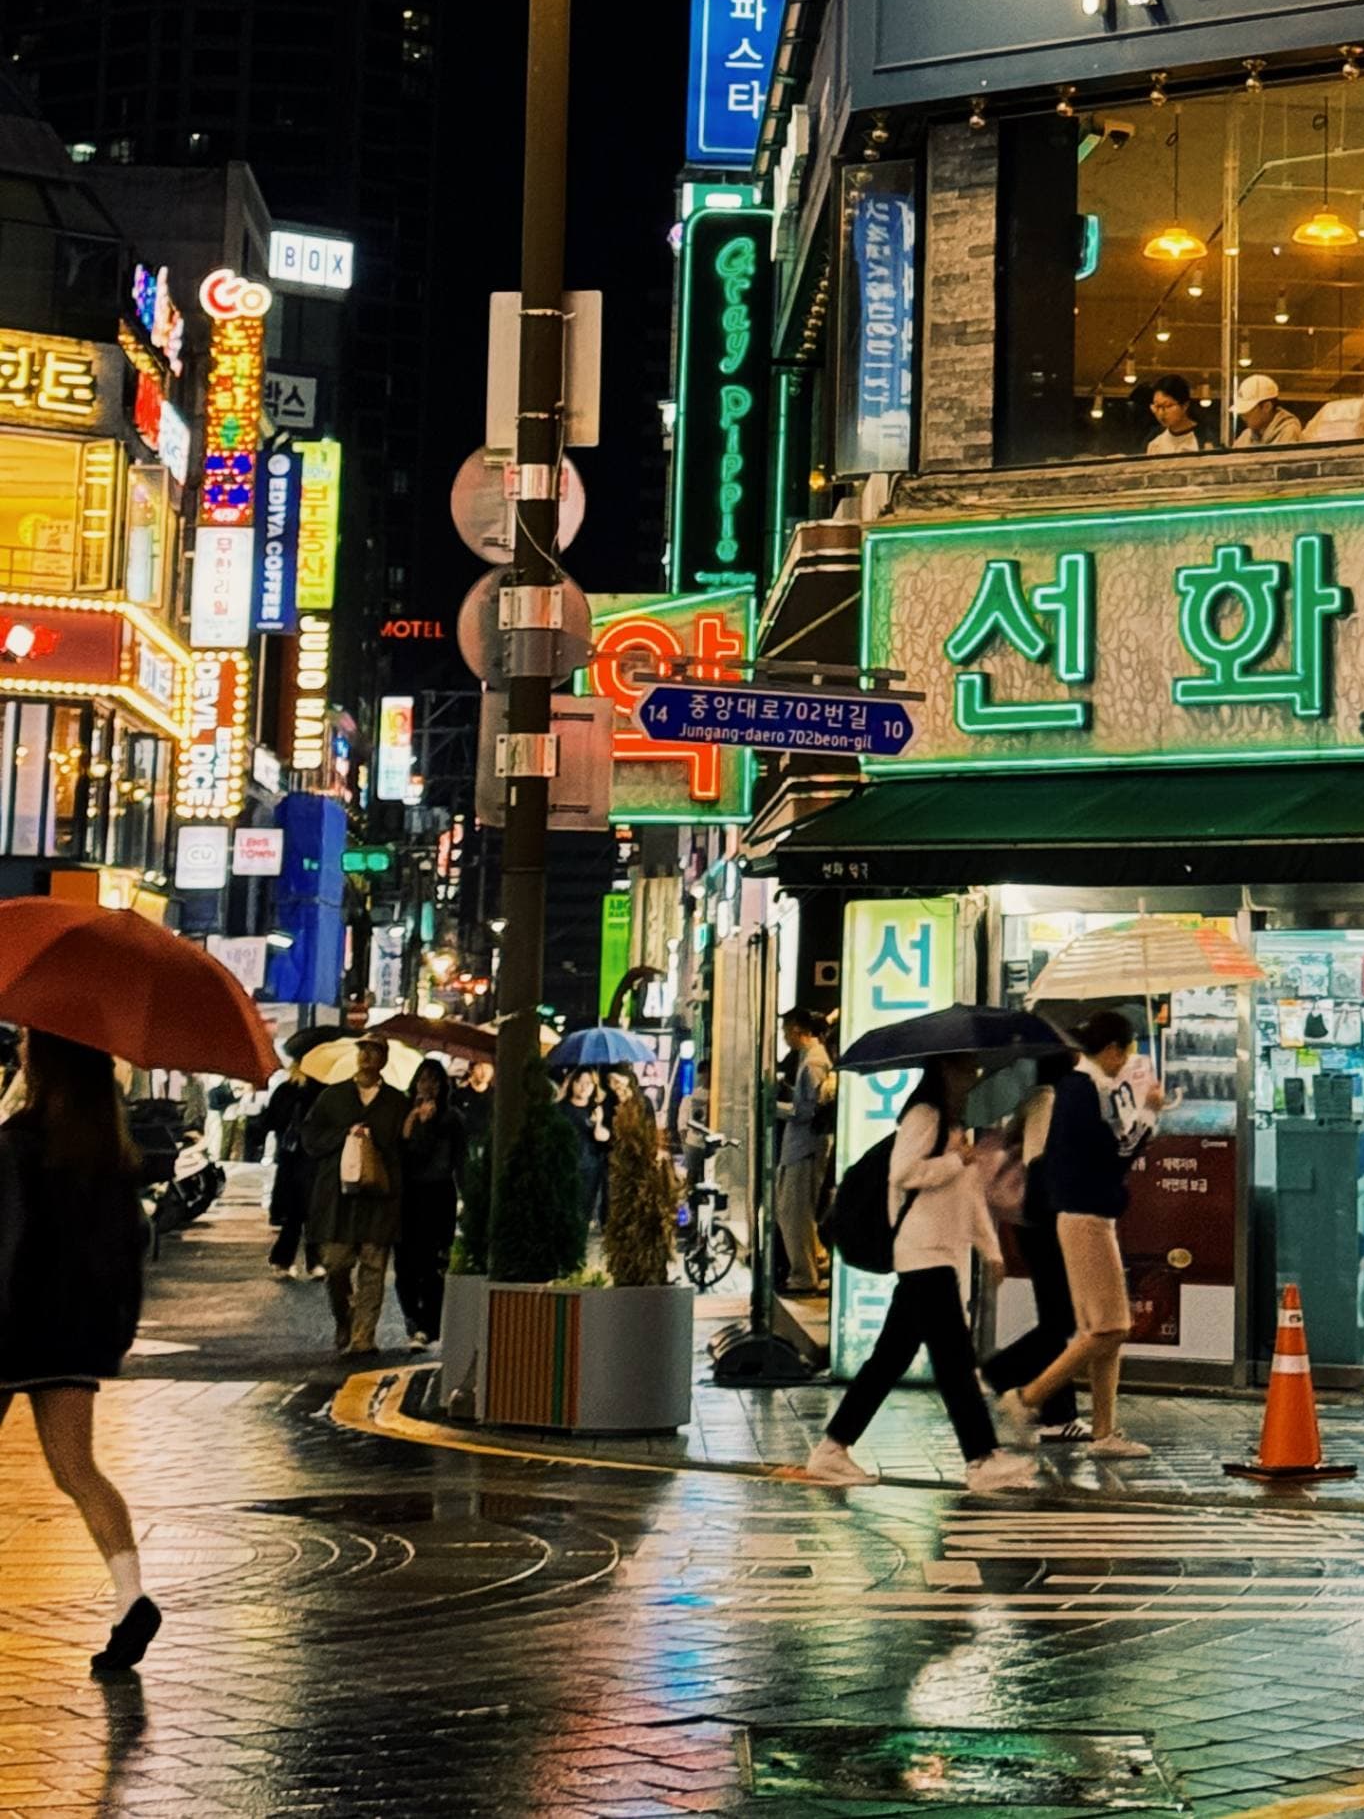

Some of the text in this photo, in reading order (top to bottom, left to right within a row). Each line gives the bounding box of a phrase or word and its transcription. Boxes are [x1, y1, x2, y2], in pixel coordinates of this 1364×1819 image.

[284, 245, 345, 275] BOX
[262, 477, 287, 621] EDIYA COFFEE
[299, 484, 330, 588] 부동산
[296, 614, 330, 690] JUNO
[943, 530, 1353, 737] 선화
[191, 660, 221, 740] DEVIL
[293, 697, 326, 769] HAIR
[648, 694, 904, 739] 14 중앙대로702번길 10
[679, 722, 872, 751] Jungang-daero 702beon-gil
[186, 743, 215, 807] DICE
